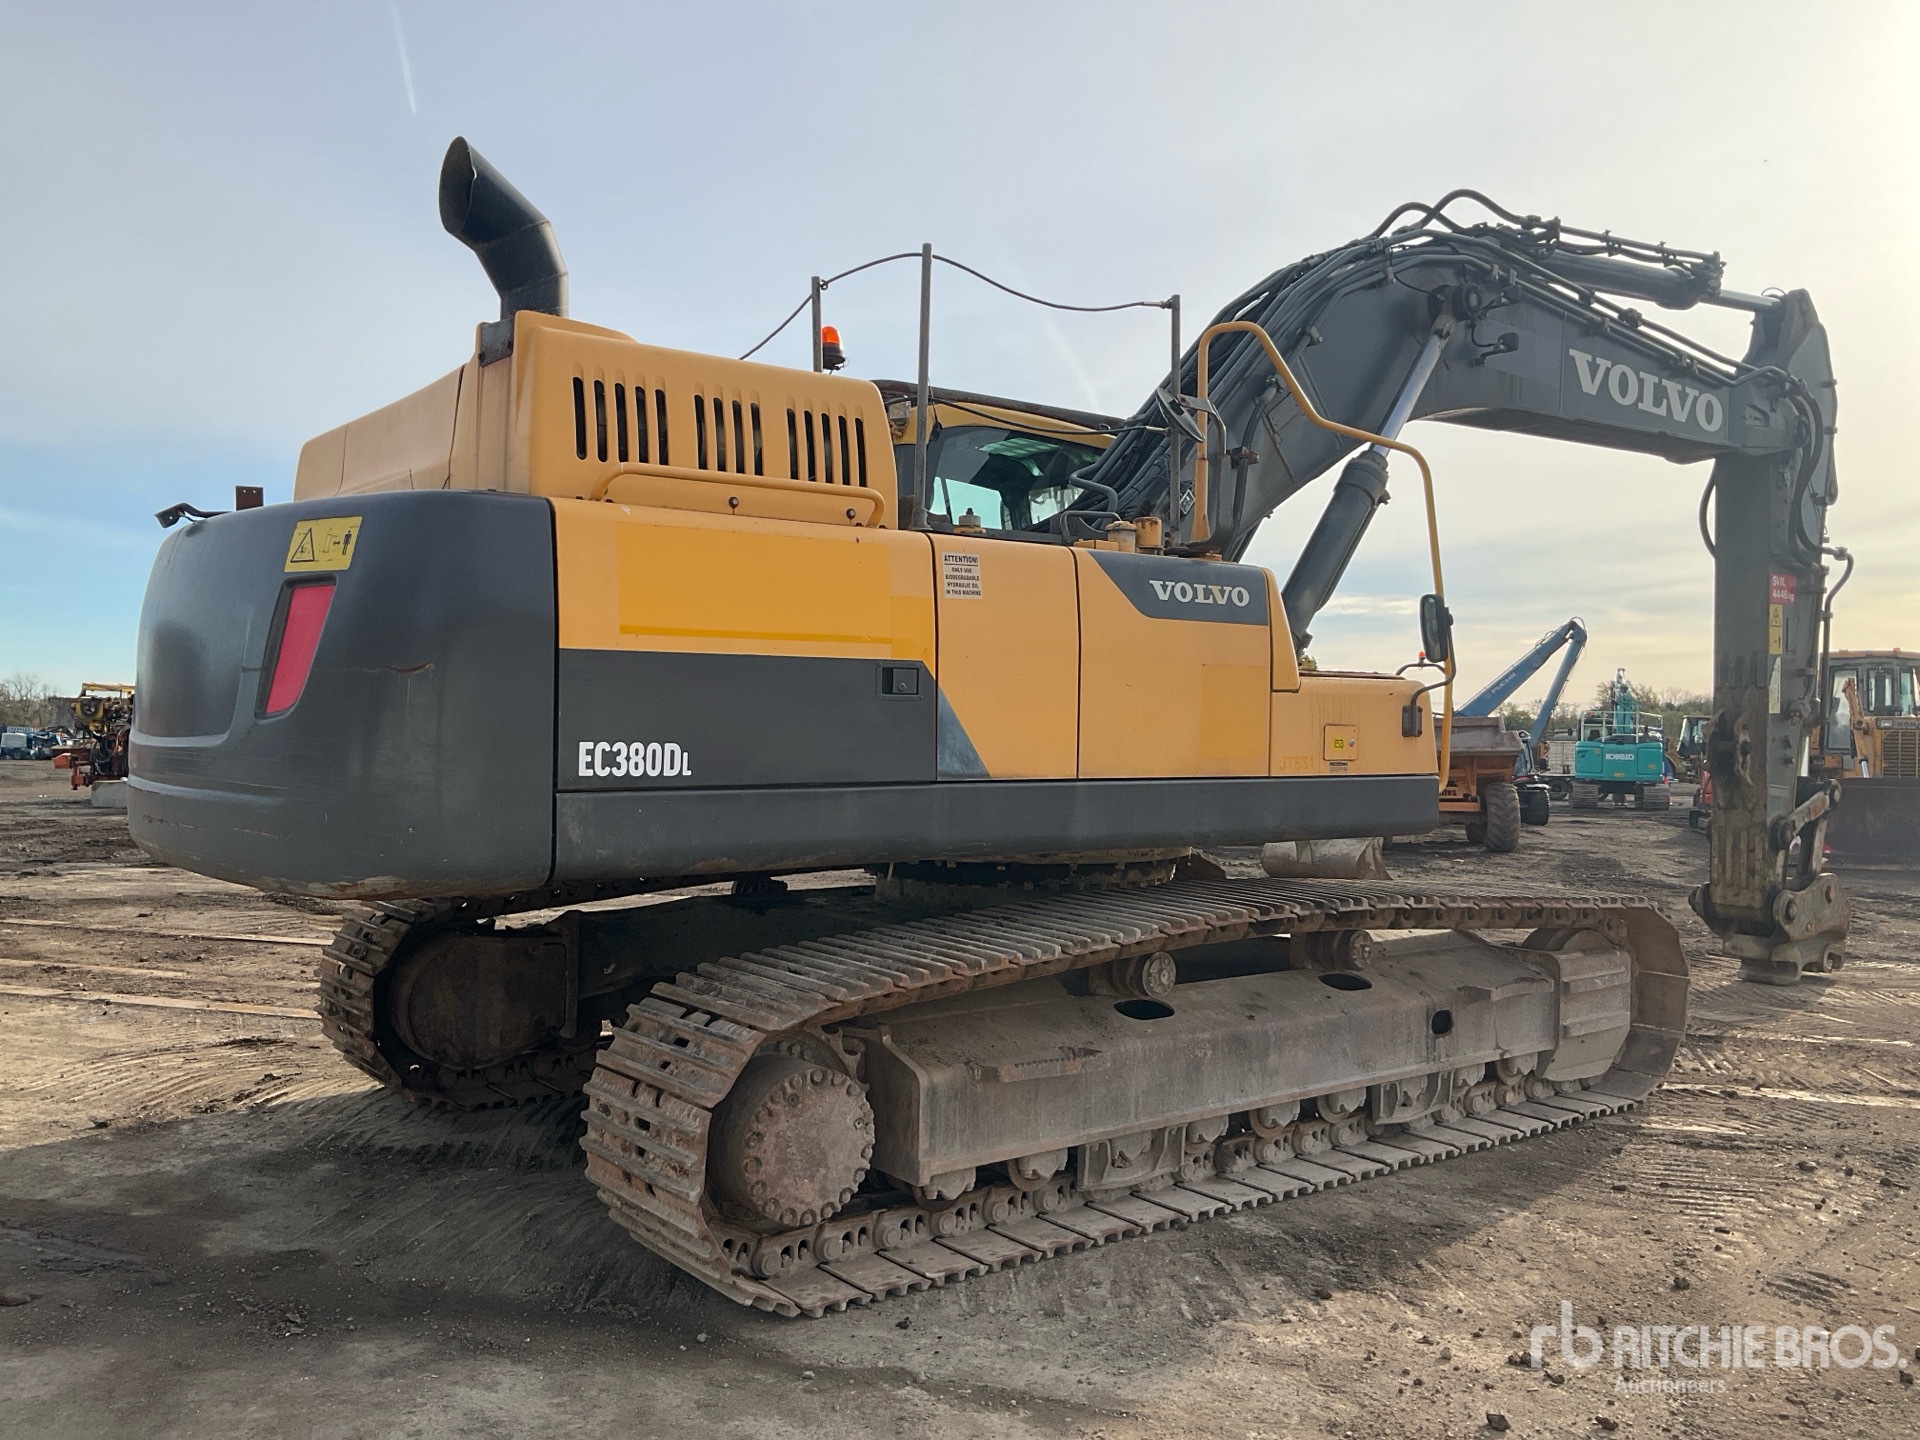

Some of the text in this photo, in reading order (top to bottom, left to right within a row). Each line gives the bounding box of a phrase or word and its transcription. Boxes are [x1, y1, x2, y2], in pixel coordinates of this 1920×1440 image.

[1569, 348, 1723, 432] VOLVO
[944, 554, 978, 563] ATTENTION!
[1772, 575, 1786, 586] SWL
[1149, 580, 1250, 607] VOLVO
